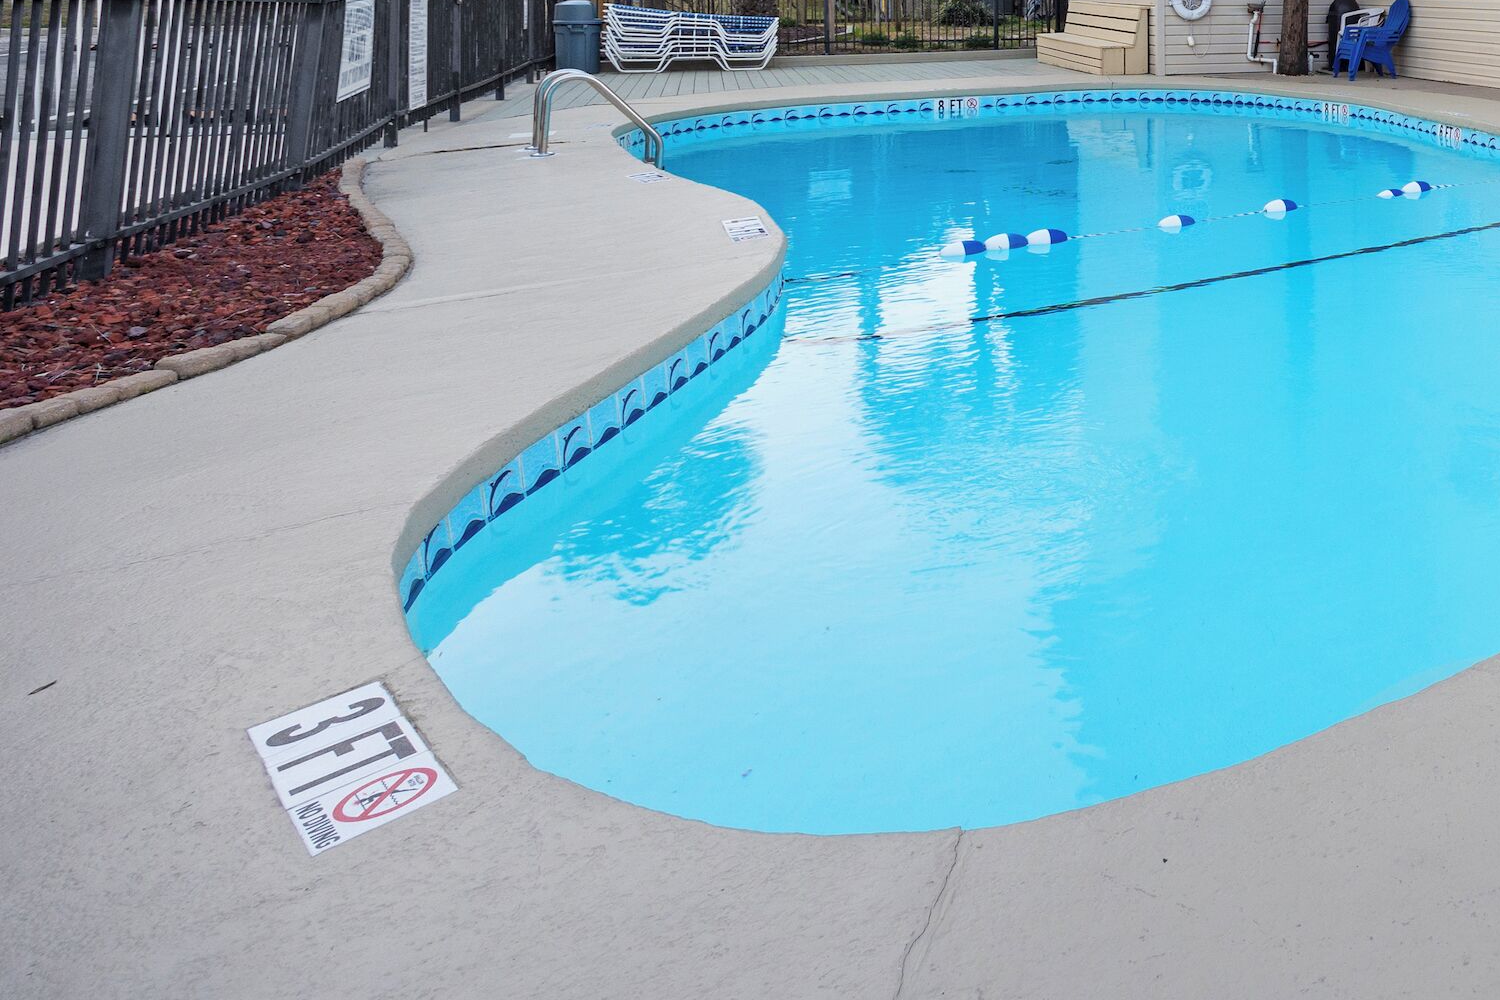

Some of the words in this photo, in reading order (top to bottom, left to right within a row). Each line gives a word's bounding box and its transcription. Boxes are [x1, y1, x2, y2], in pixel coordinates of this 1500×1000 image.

[951, 99, 963, 110] FT
[265, 696, 386, 748] 3
[276, 720, 418, 797] FT
[295, 800, 324, 820] NO
[302, 813, 341, 850] DIVING
